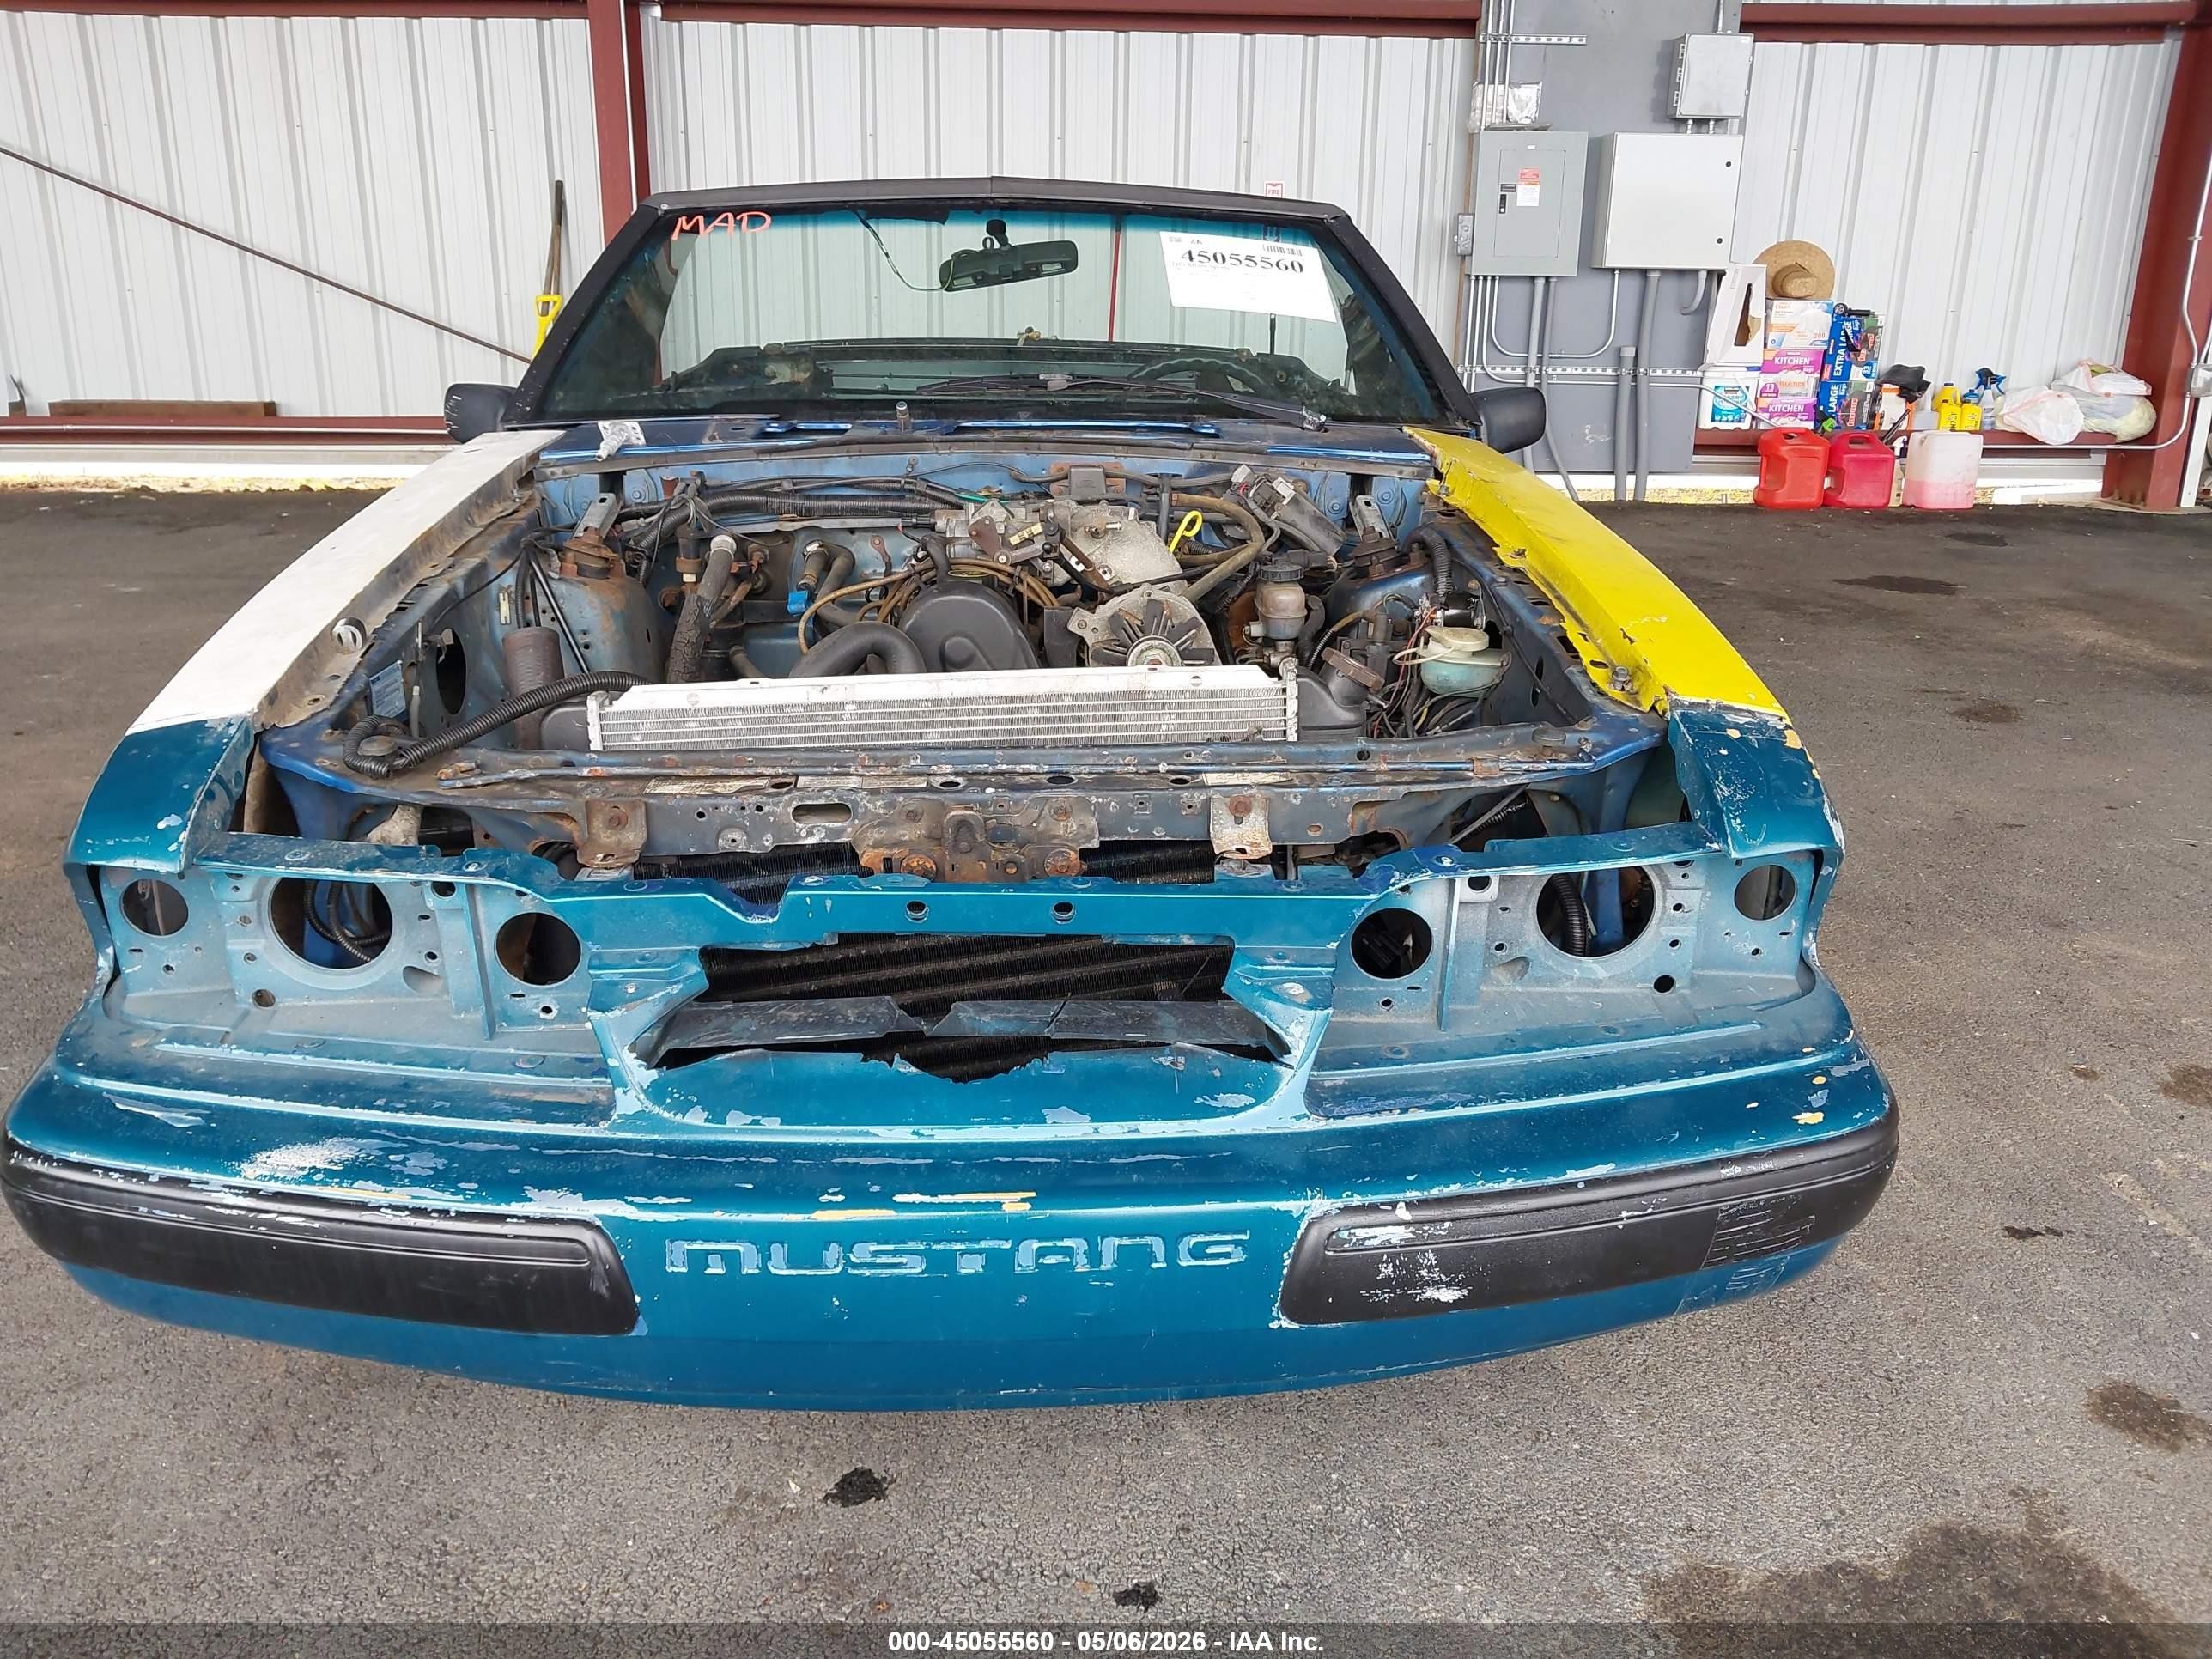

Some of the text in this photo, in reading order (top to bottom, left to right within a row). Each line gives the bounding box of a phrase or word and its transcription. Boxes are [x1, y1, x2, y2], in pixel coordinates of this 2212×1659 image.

[672, 210, 772, 241] MAD
[1181, 249, 1304, 274] 45055560
[1774, 356, 1810, 366] KITCHEN
[1833, 349, 1846, 377] EXTRA
[1769, 404, 1805, 413] KITCHEN
[1828, 384, 1839, 413] LARGE
[665, 1230, 1251, 1275] MUSTANG
